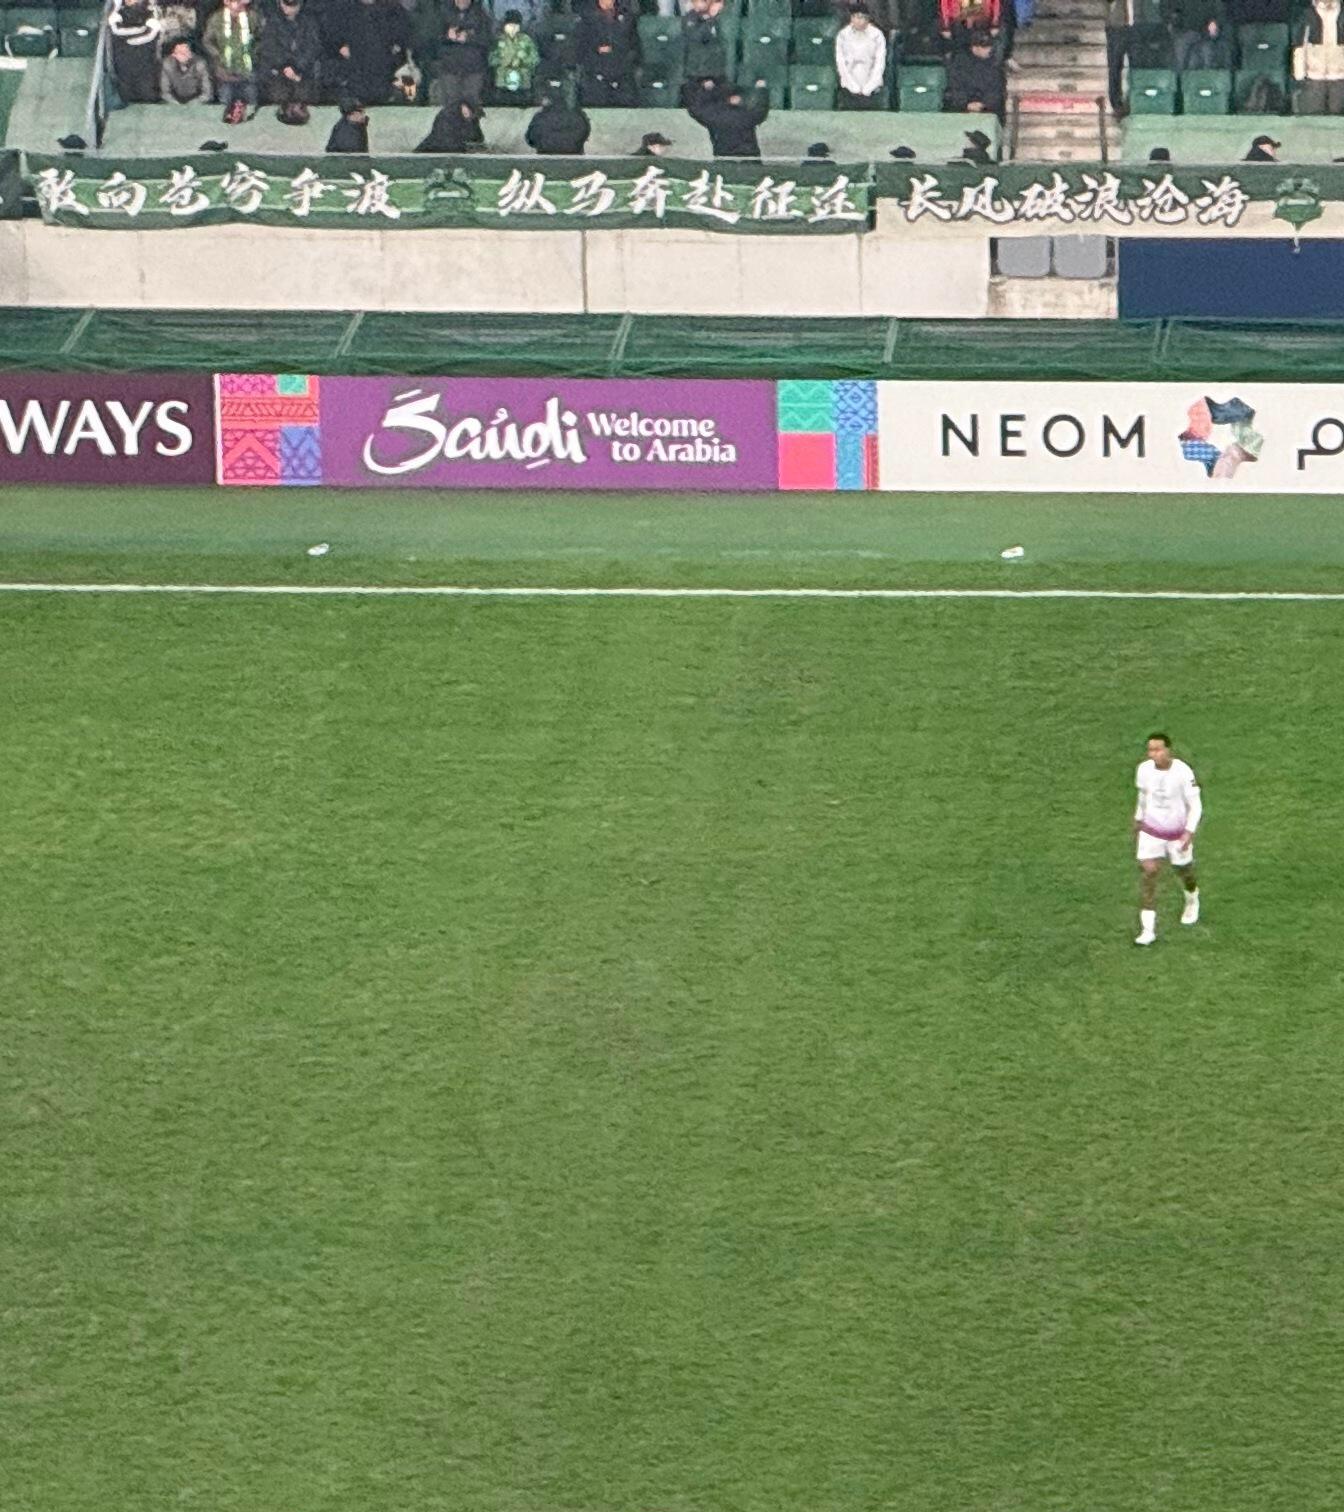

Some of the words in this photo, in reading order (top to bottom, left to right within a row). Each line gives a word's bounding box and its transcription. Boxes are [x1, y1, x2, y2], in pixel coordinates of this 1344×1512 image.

[497, 165, 867, 224] 纵马奔赴征途
[902, 171, 1250, 226] 长风破浪沧海
[586, 411, 716, 438] Welcome
[940, 412, 1147, 458] NEOM
[612, 438, 641, 463] to
[646, 437, 738, 464] Arabia
